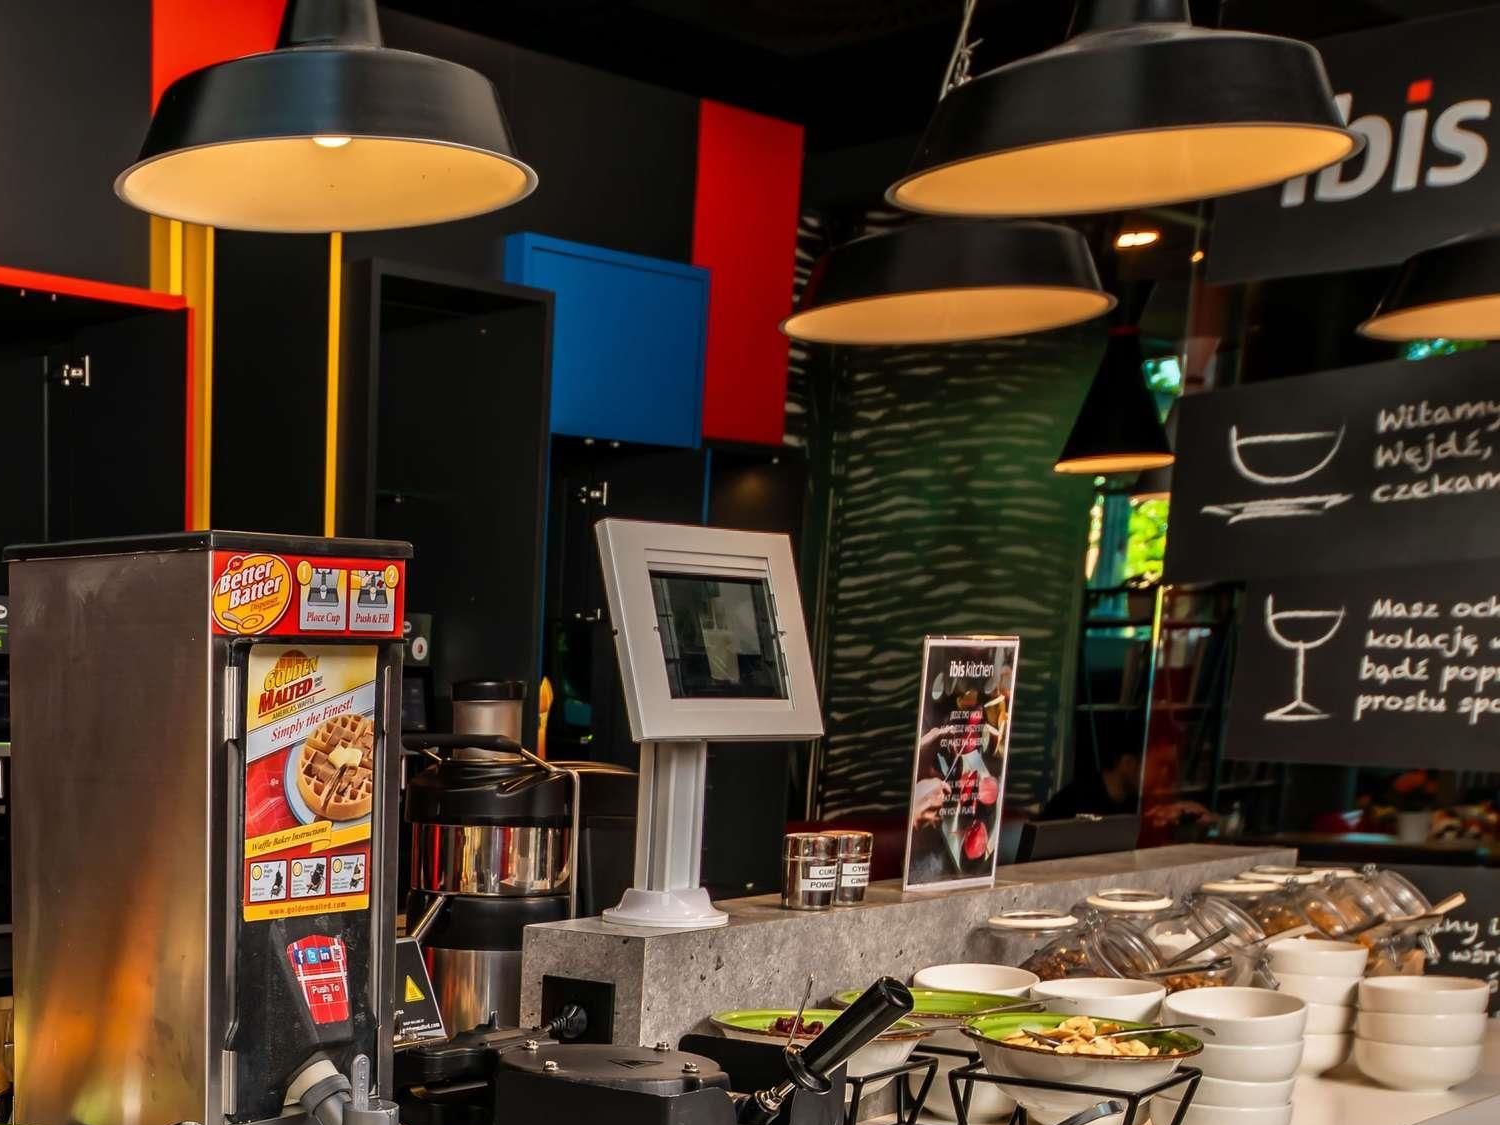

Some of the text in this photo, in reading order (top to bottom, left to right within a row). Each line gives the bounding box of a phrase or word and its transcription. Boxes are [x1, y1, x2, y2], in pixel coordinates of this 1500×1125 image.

[218, 560, 275, 595] Better
[229, 575, 283, 610] Batter
[306, 611, 341, 625] Place Cup
[355, 612, 370, 624] Push
[377, 612, 390, 625] Fill
[1369, 598, 1440, 620] Masz
[1365, 625, 1479, 659] kolację
[949, 660, 995, 678] ibis kitchen
[1359, 654, 1500, 694] bądź pop
[258, 677, 313, 715] MALTED
[1352, 689, 1447, 722] prostu
[271, 695, 355, 742] Simply the Finest!
[251, 826, 328, 852] Waffle Baker Instructions
[311, 983, 340, 994] Push To
